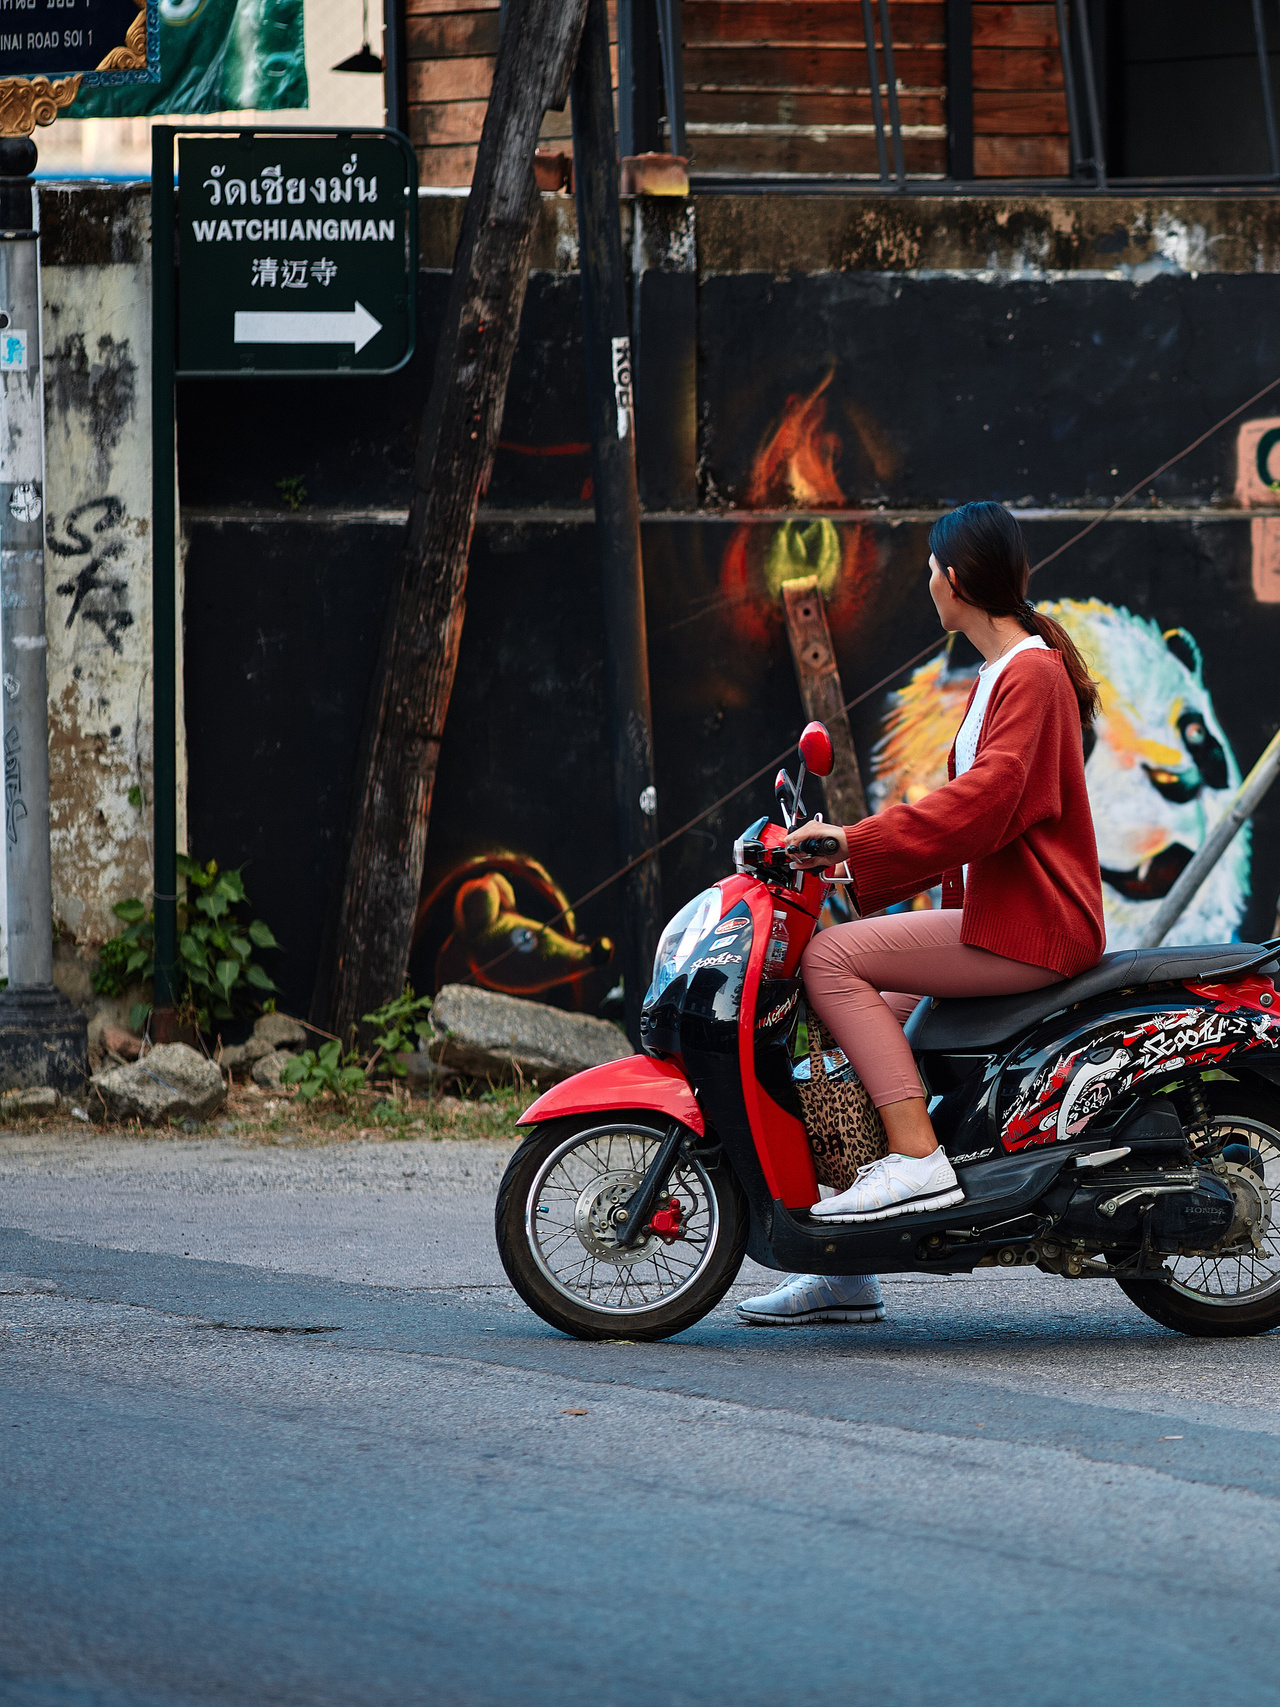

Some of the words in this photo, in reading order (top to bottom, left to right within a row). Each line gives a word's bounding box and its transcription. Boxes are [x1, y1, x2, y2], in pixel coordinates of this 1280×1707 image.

[27, 31, 59, 49] ROAD
[63, 29, 83, 48] SOI
[87, 29, 93, 46] 1
[203, 153, 379, 206] วัดเชียงมั่น
[192, 218, 396, 243] WATCHIANGMAN
